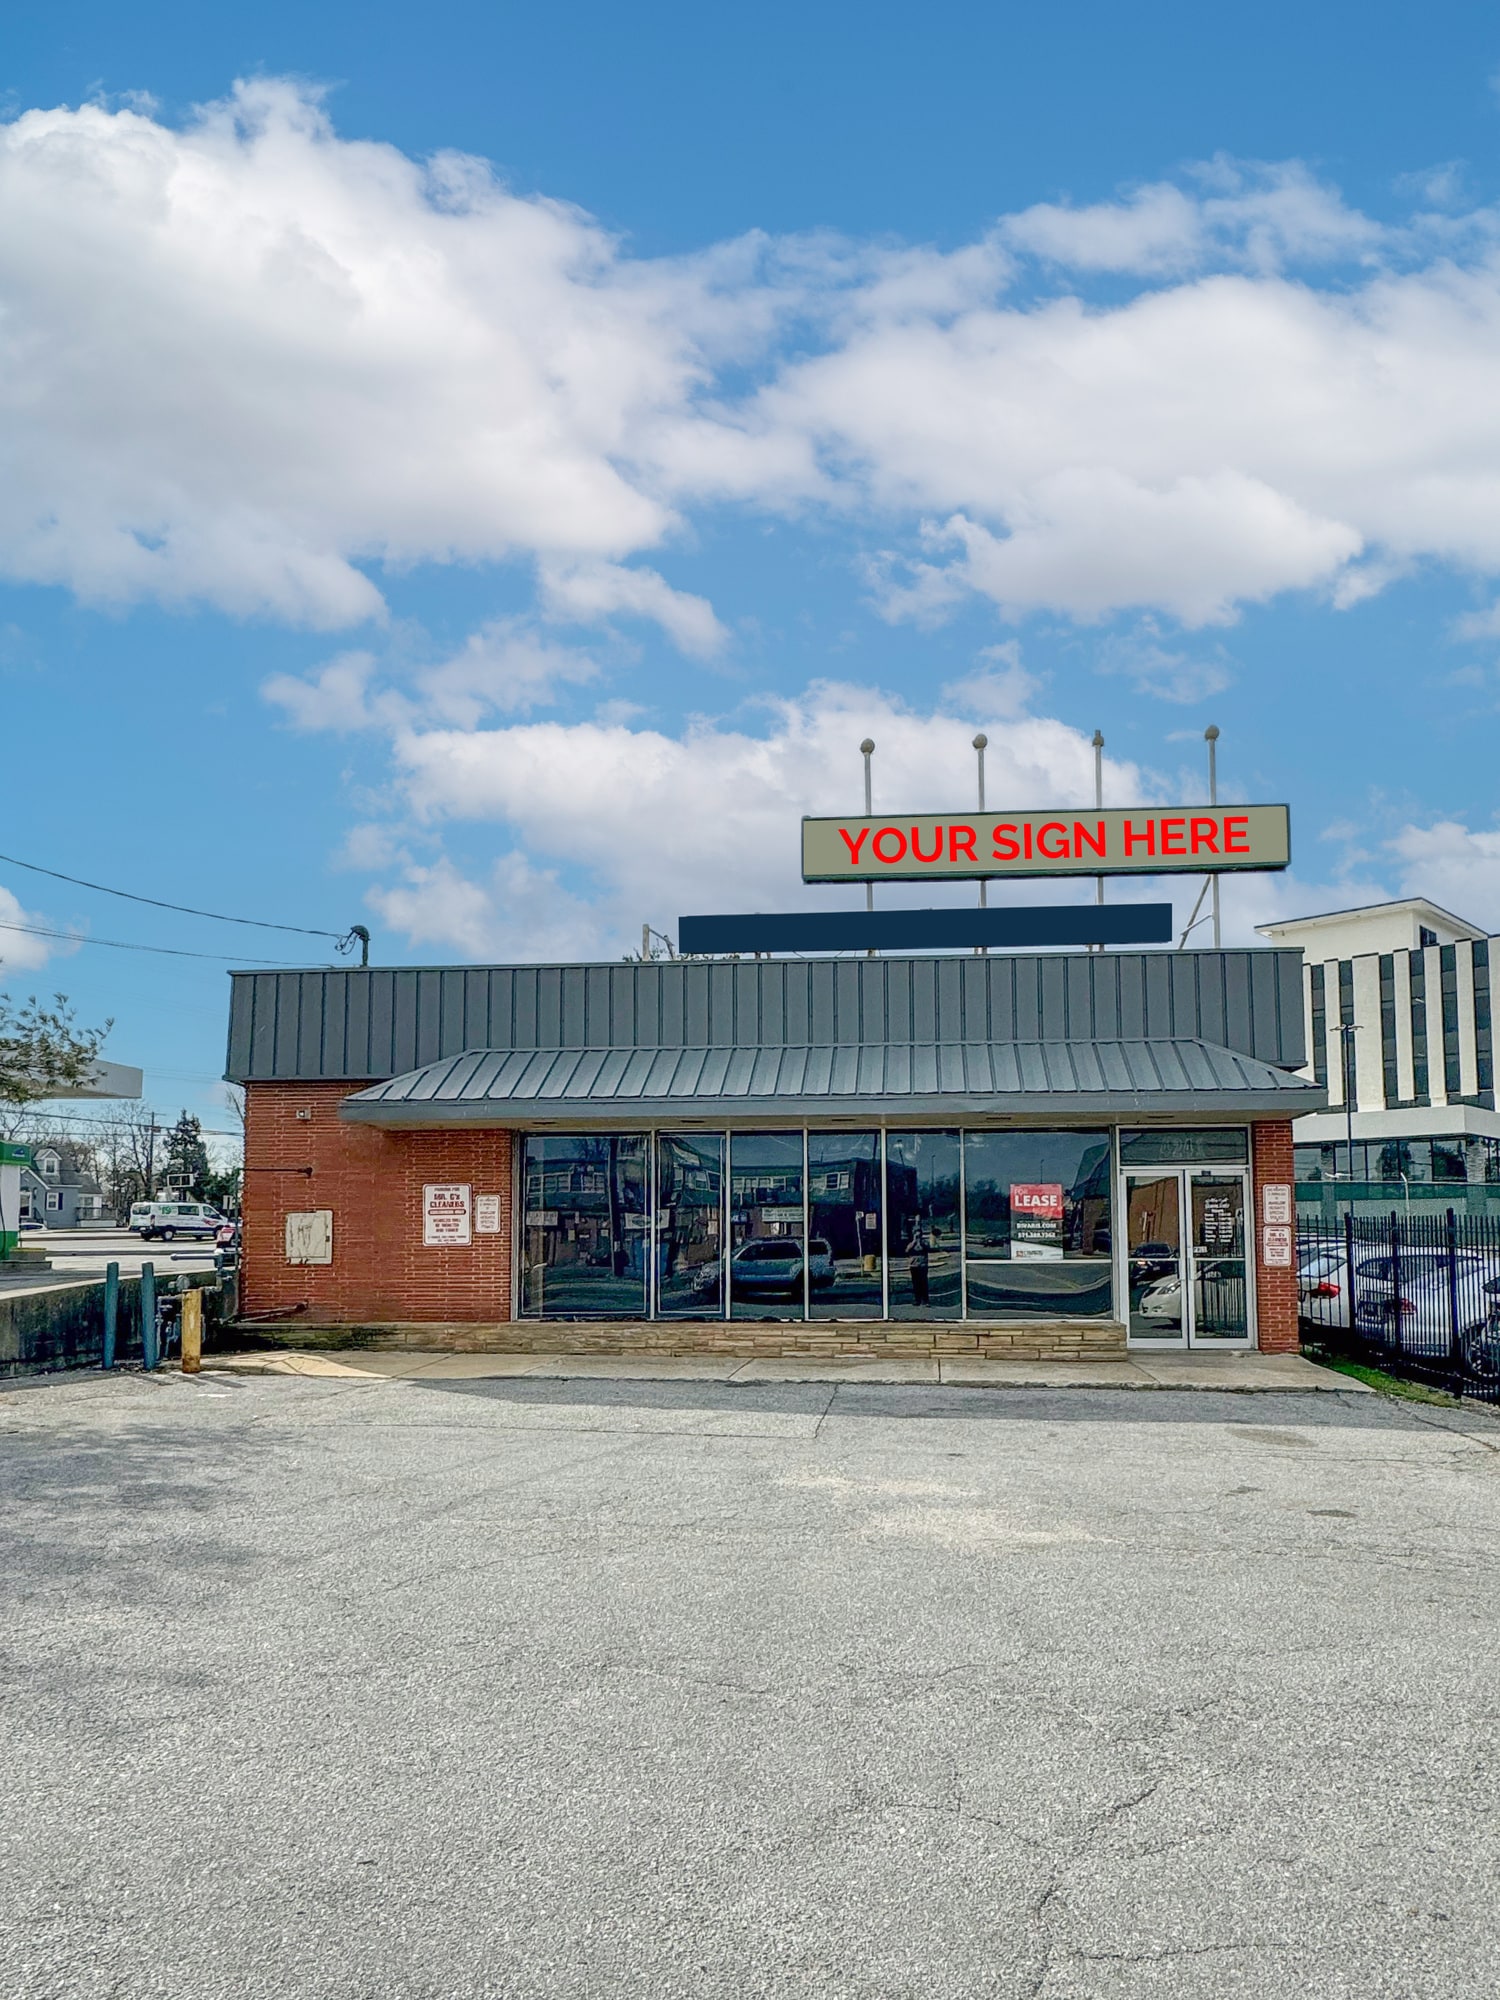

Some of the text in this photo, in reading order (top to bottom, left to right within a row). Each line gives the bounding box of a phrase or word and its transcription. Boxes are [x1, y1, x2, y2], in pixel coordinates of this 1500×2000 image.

[839, 817, 1250, 865] YOUR SIGN HERE
[1014, 1195, 1058, 1206] LEASE
